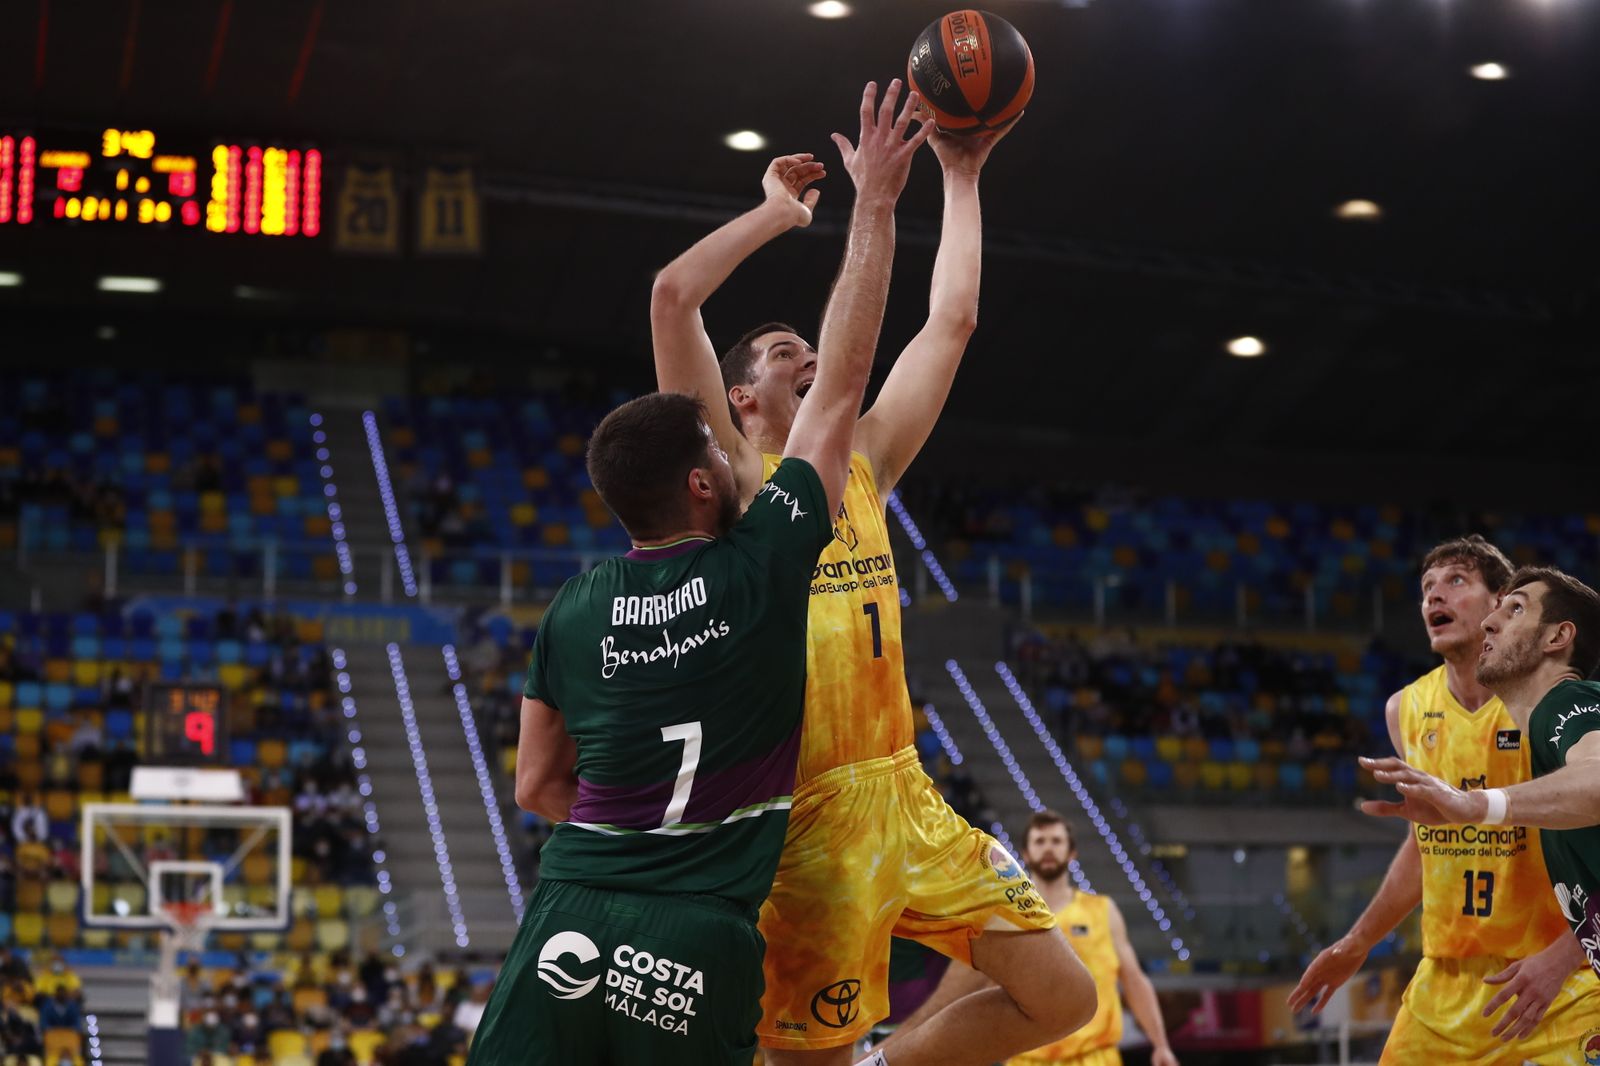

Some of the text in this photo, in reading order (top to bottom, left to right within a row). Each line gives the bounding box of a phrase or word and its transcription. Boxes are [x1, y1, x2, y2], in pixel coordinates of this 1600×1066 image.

[612, 577, 707, 626] BARREIRO
[810, 584, 826, 595] sla
[863, 576, 878, 588] del
[863, 601, 882, 658] 1
[184, 711, 214, 757] 9
[660, 721, 703, 827] 7
[1433, 845, 1475, 857] Europea
[1478, 847, 1492, 857] del
[1462, 870, 1494, 917] 13
[605, 968, 697, 1017] DEL SOL
[613, 944, 703, 995] COSTA
[604, 989, 688, 1036] MÁLAGA
